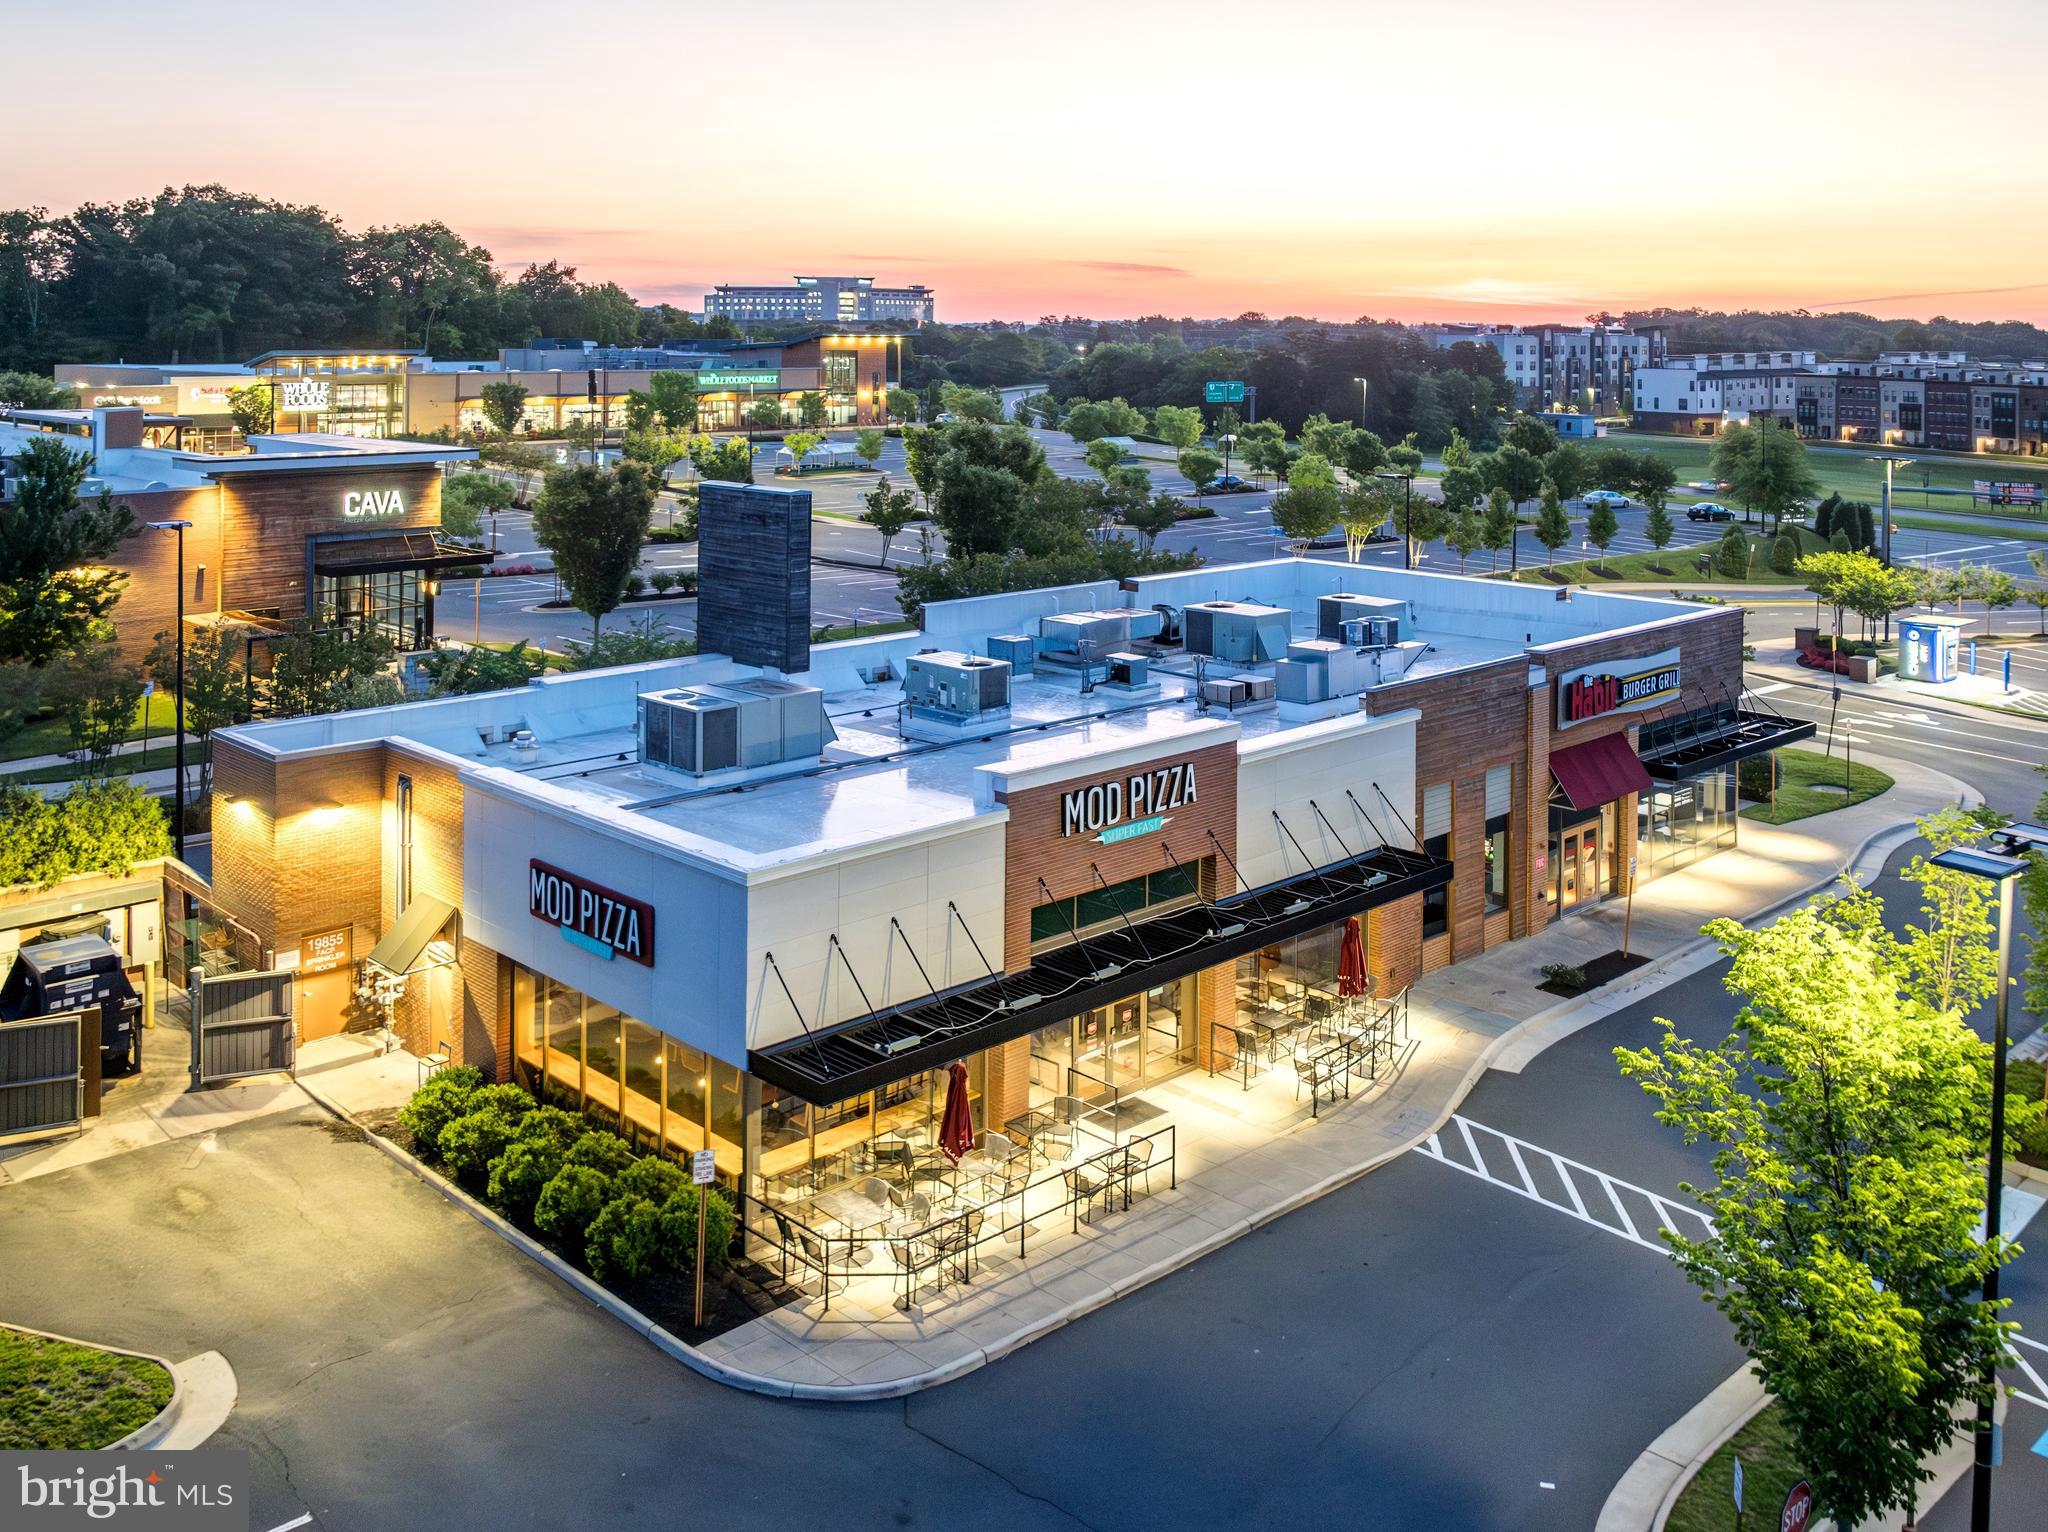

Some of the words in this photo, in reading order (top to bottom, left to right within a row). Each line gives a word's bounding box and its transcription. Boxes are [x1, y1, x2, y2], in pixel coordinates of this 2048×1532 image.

[281, 380, 330, 395] WHOLE
[699, 373, 726, 384] WHOLE
[726, 376, 748, 384] FOODS
[749, 375, 777, 384] MARKET
[284, 394, 328, 406] FOODS
[345, 490, 404, 515] CAVA
[1583, 675, 1593, 688] the
[1623, 678, 1657, 700] BURGER
[1658, 667, 1681, 690] GRILL
[1572, 675, 1617, 721] Habit
[1064, 781, 1122, 838] MOD
[1130, 763, 1198, 820] PIZZA
[1106, 827, 1136, 843] SUPER
[1138, 820, 1160, 835] FAST
[531, 867, 575, 926] MOD
[581, 888, 641, 957] PIZZA
[307, 933, 344, 951] 19855
[305, 951, 346, 966] SPRINKLER
[315, 961, 337, 972] ROOM
[1784, 1496, 1810, 1532] STOP
